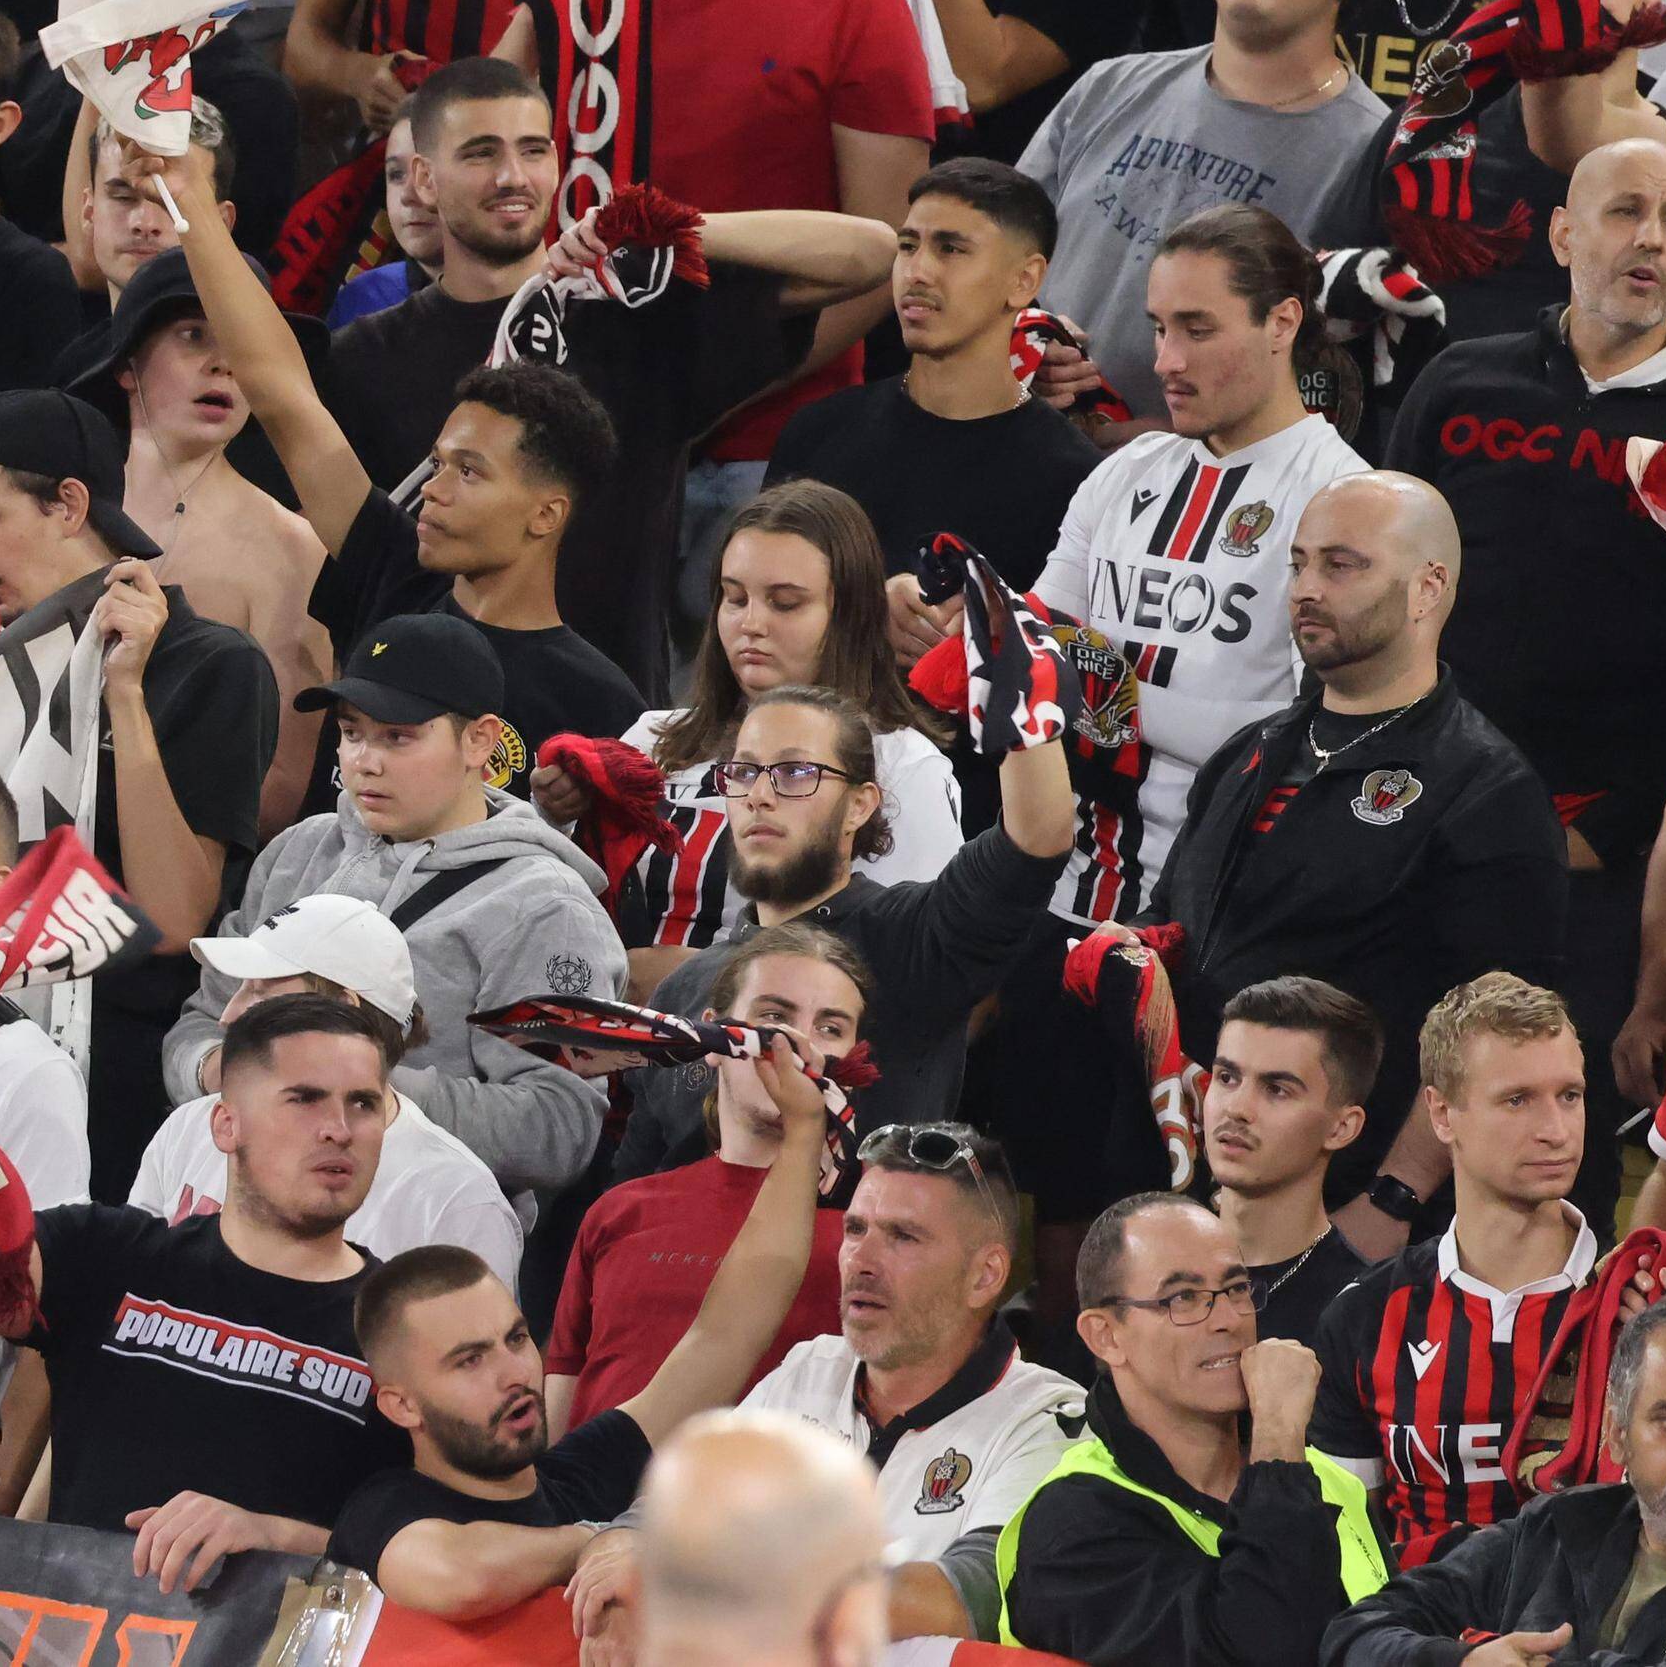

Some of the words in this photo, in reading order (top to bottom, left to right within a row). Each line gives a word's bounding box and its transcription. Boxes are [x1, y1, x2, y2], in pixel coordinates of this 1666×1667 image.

[1107, 135, 1276, 206] ADVENTURE
[1441, 416, 1561, 462] OGC
[1092, 556, 1258, 643] INEOS
[1077, 658, 1114, 681] NICE
[114, 1308, 296, 1385] POPULAIRE
[299, 1358, 373, 1407] SUD
